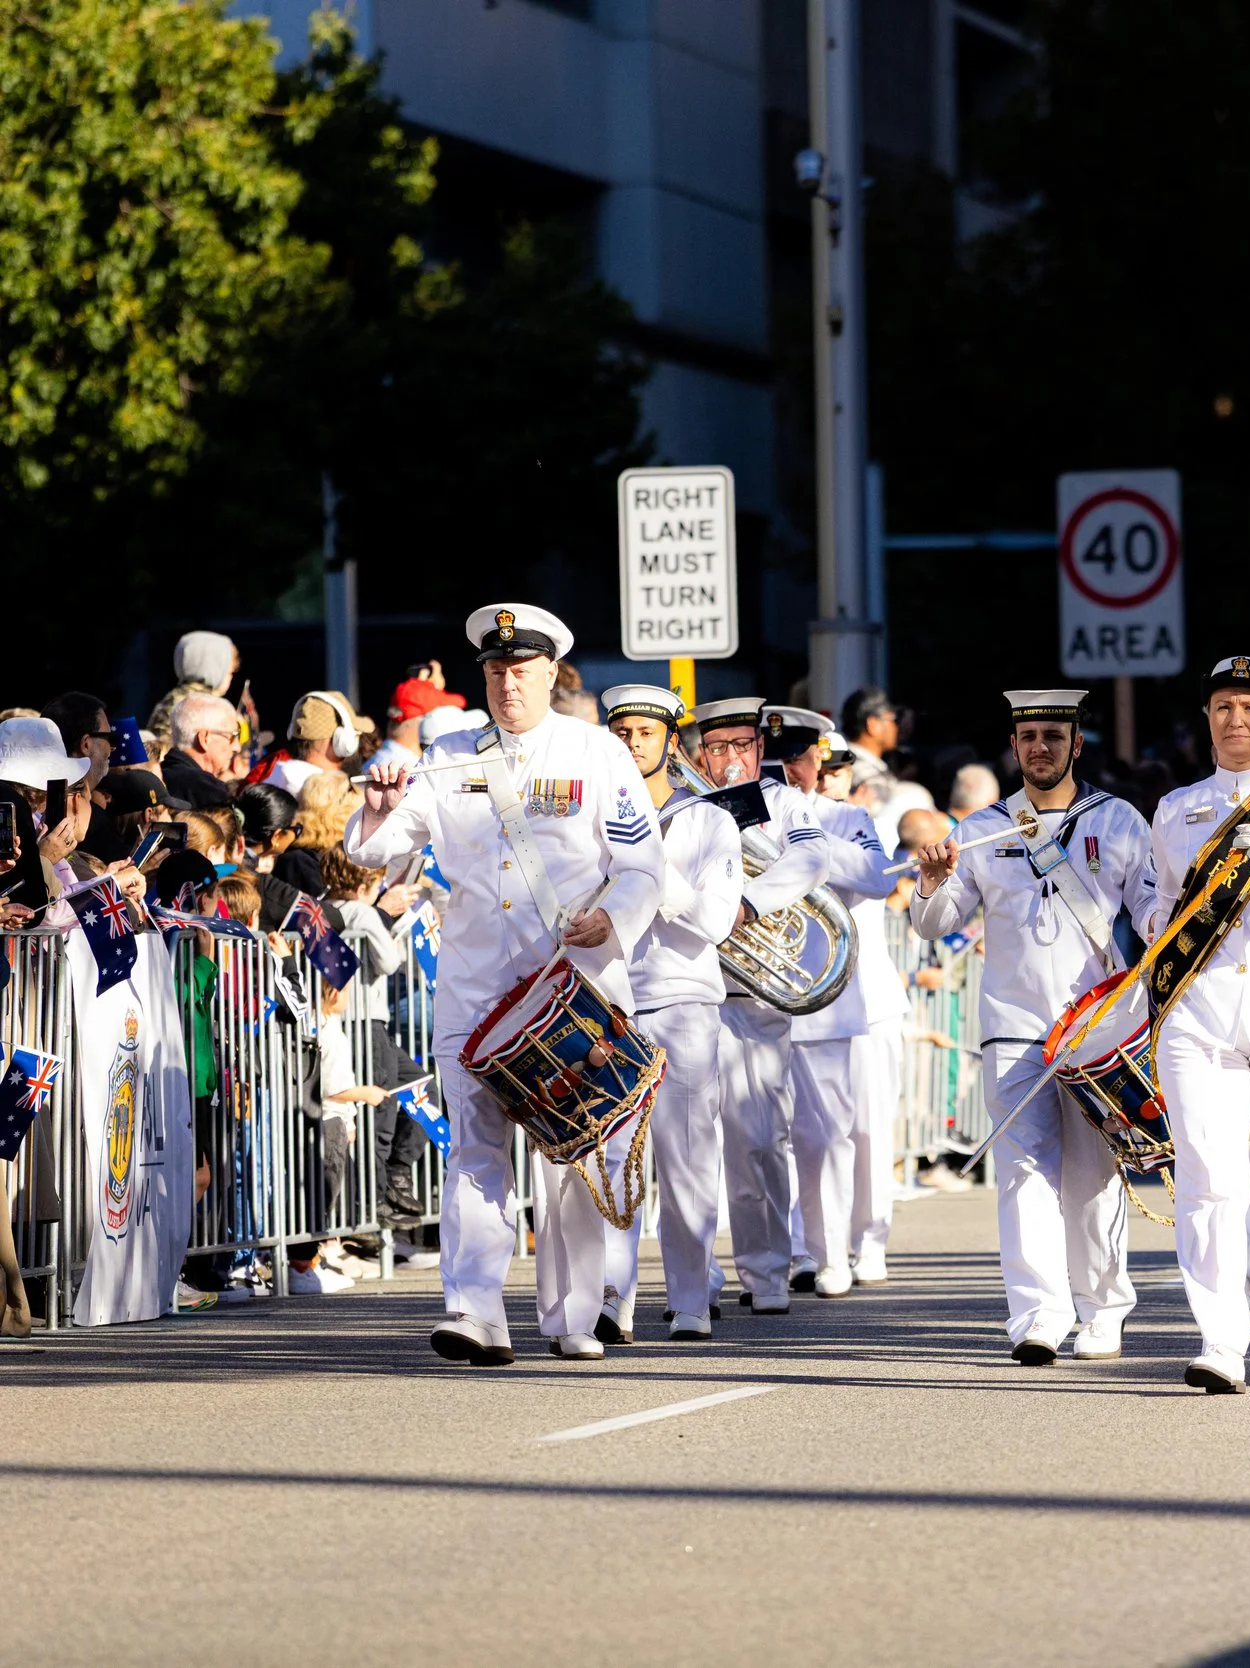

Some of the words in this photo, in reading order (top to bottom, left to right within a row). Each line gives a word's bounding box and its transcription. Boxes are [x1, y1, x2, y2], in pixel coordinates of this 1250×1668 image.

[635, 487, 718, 511] RIGHT
[641, 519, 714, 542] LANE
[1083, 522, 1159, 575] 40
[640, 552, 716, 575] MUST
[642, 584, 716, 607] TURN
[637, 617, 722, 641] RIGHT
[1067, 624, 1177, 662] AREA
